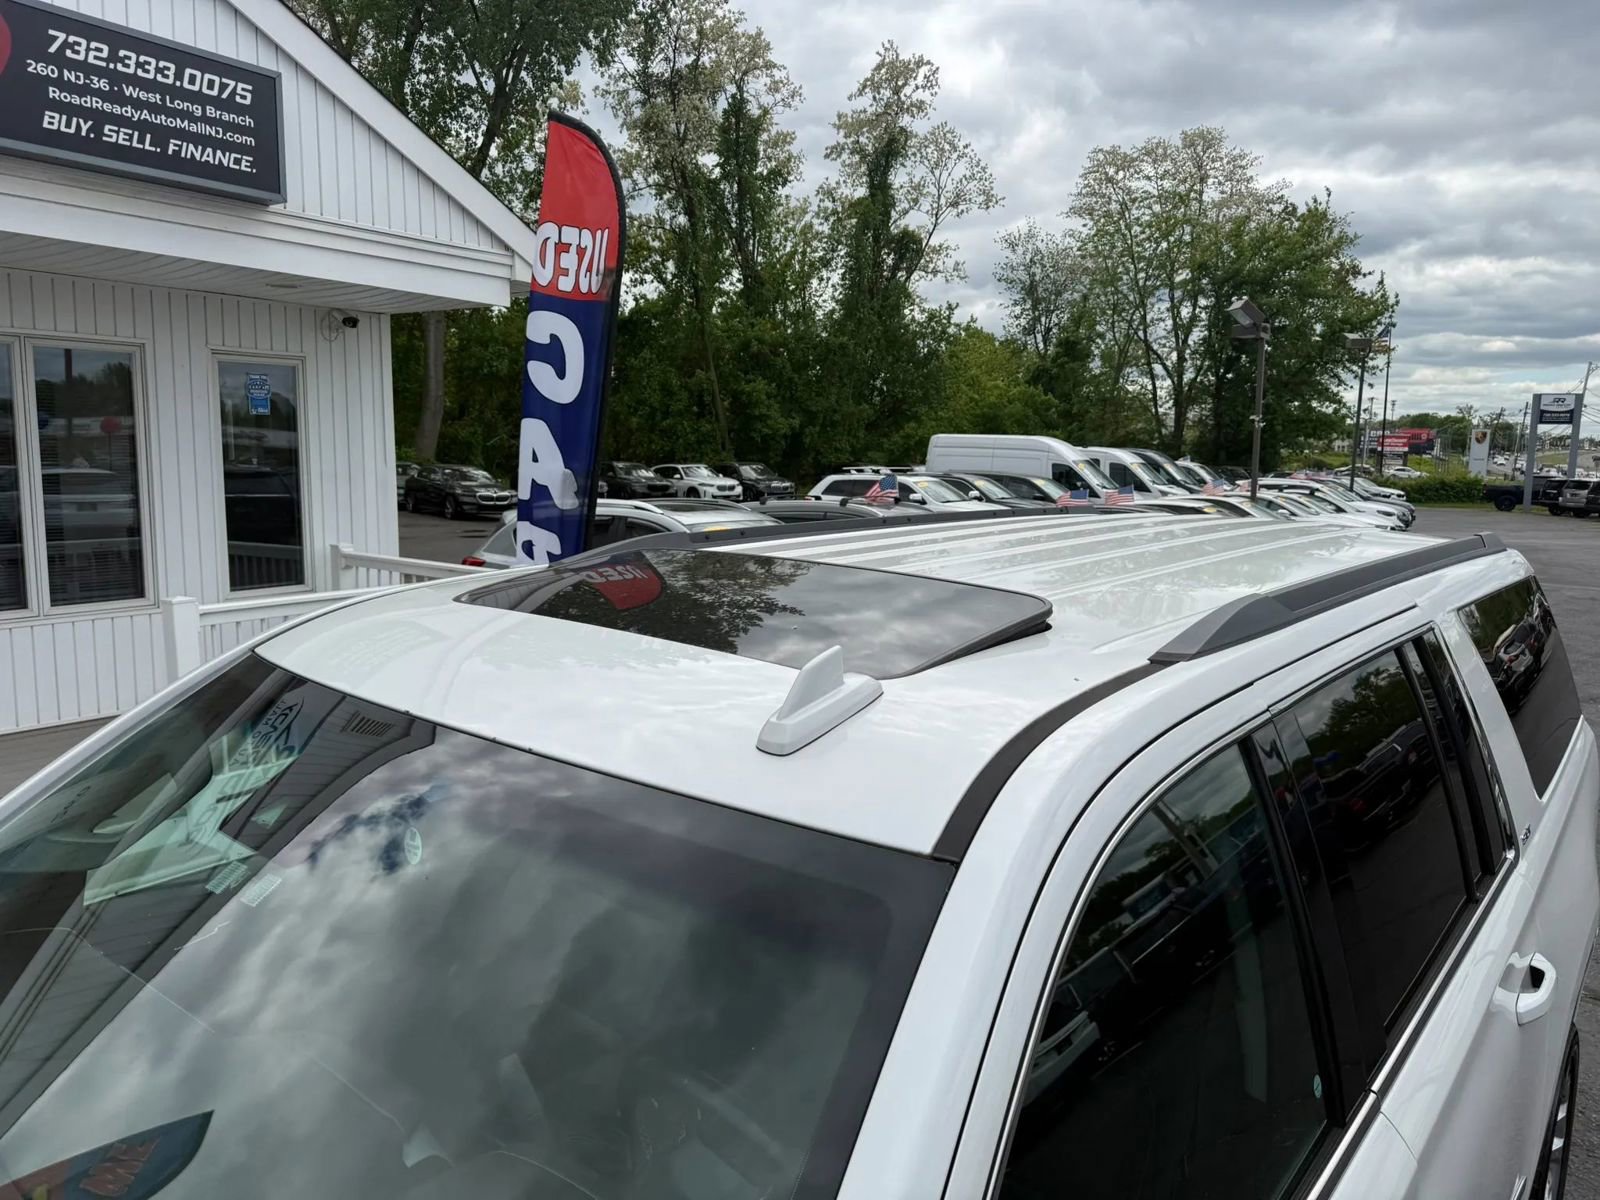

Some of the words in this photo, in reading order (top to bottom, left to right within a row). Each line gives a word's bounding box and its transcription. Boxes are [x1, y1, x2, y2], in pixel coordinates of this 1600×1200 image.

[26, 59, 58, 78] 260
[63, 68, 110, 91] NJ-36
[122, 84, 162, 105] West
[166, 95, 202, 117] Long
[206, 105, 254, 128] Branch
[47, 29, 253, 105] 732.333.0075
[42, 111, 95, 138] BUY.
[102, 125, 161, 152] SELL.
[168, 139, 257, 173] FINANCE.
[48, 86, 255, 147] RoadReadyAutoMallNJ.com
